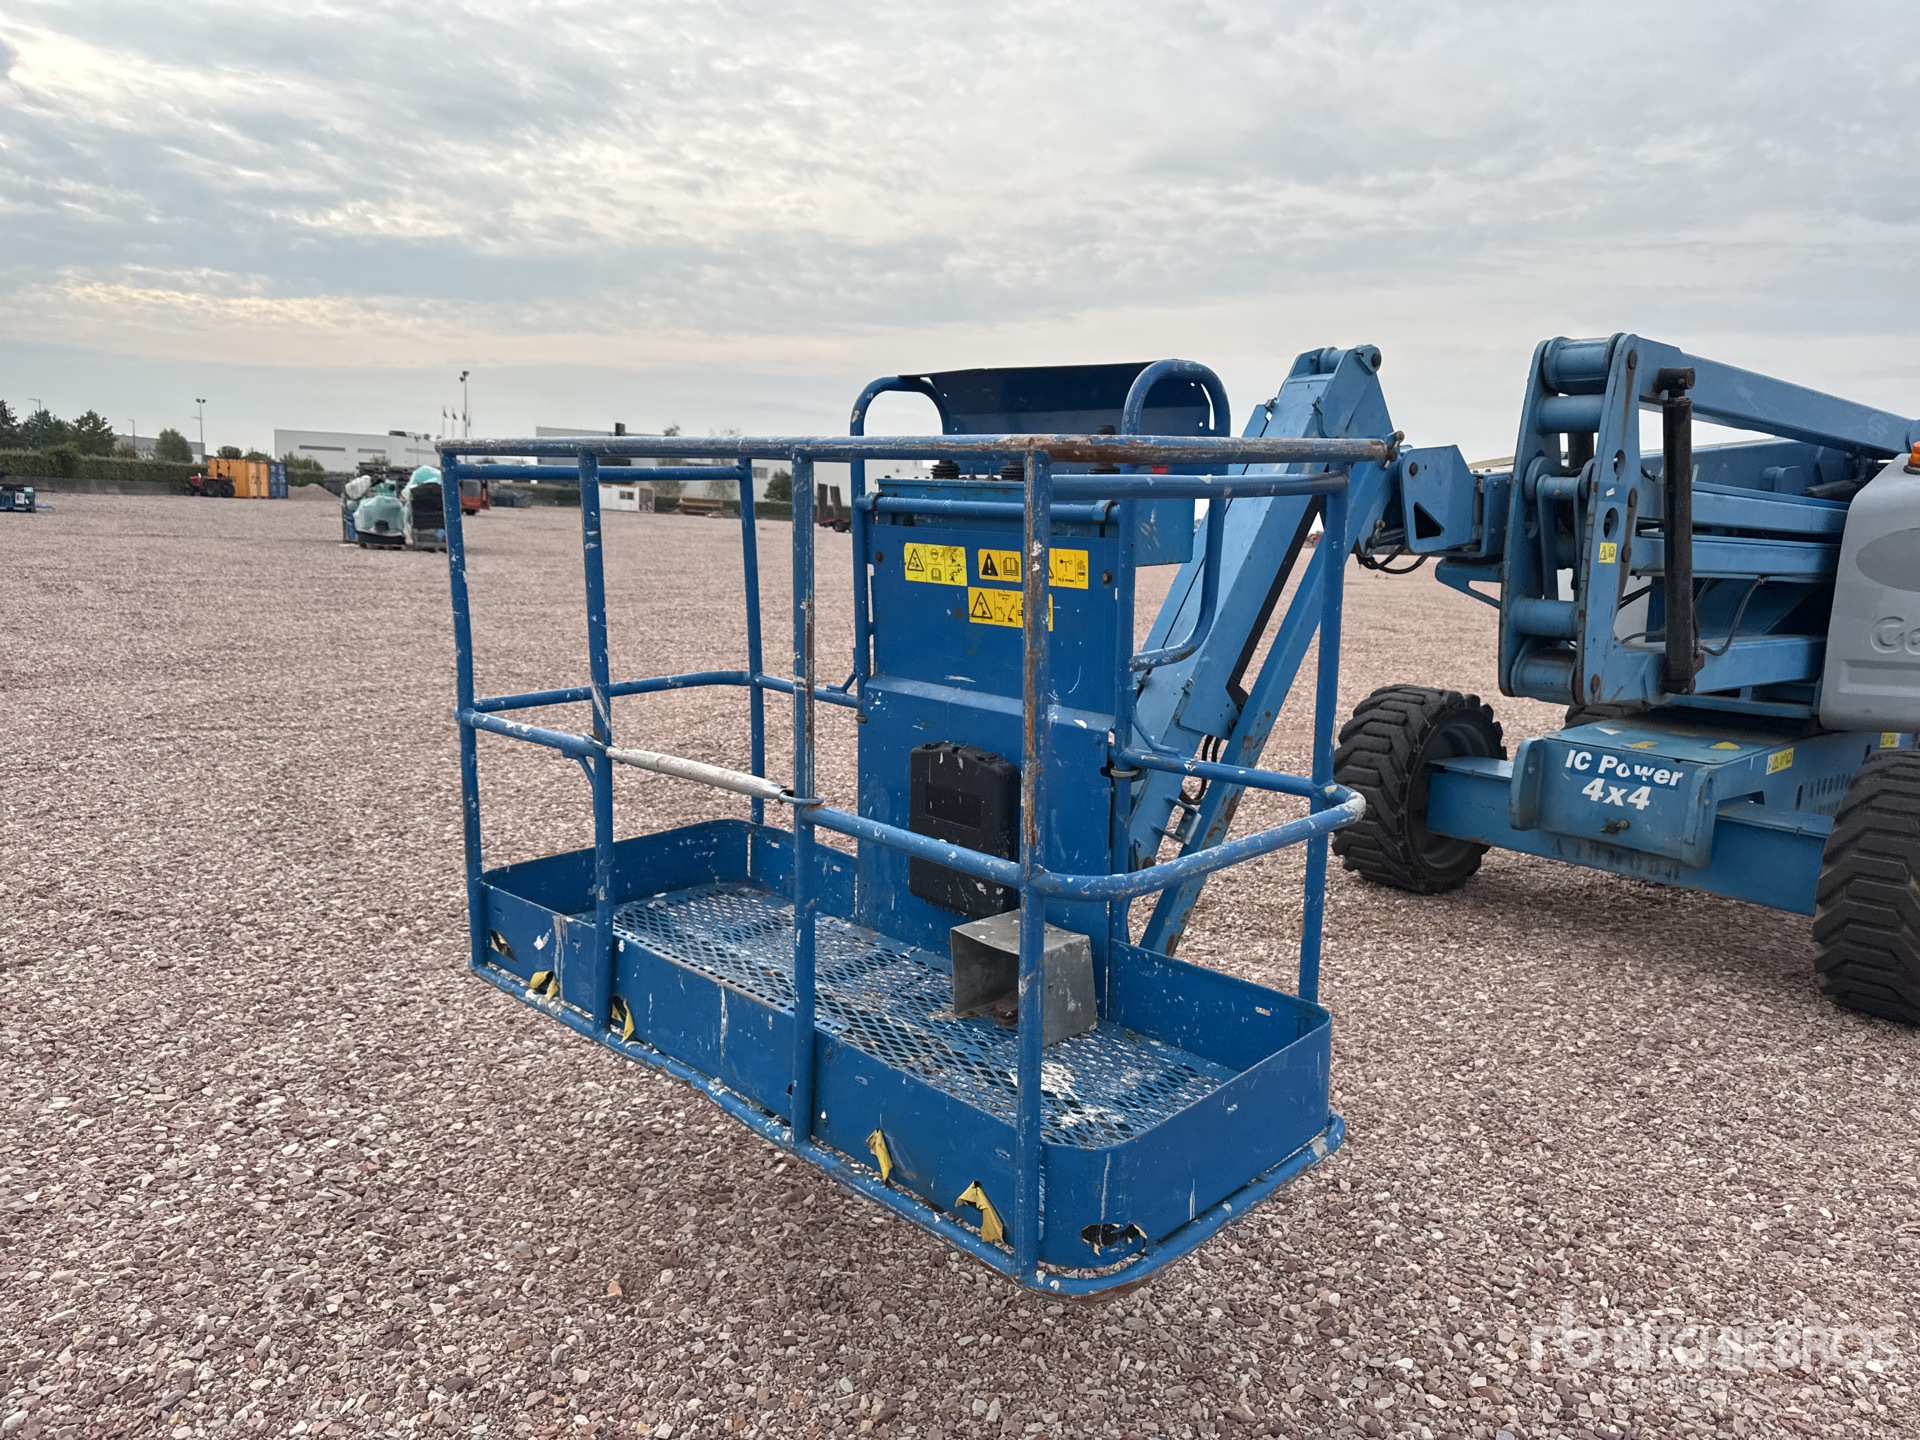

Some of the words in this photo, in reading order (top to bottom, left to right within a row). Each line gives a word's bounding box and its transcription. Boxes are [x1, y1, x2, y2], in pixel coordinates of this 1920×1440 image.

[1565, 749, 1592, 771] IC
[1597, 755, 1684, 786] Power
[1581, 777, 1652, 811] 4x4
